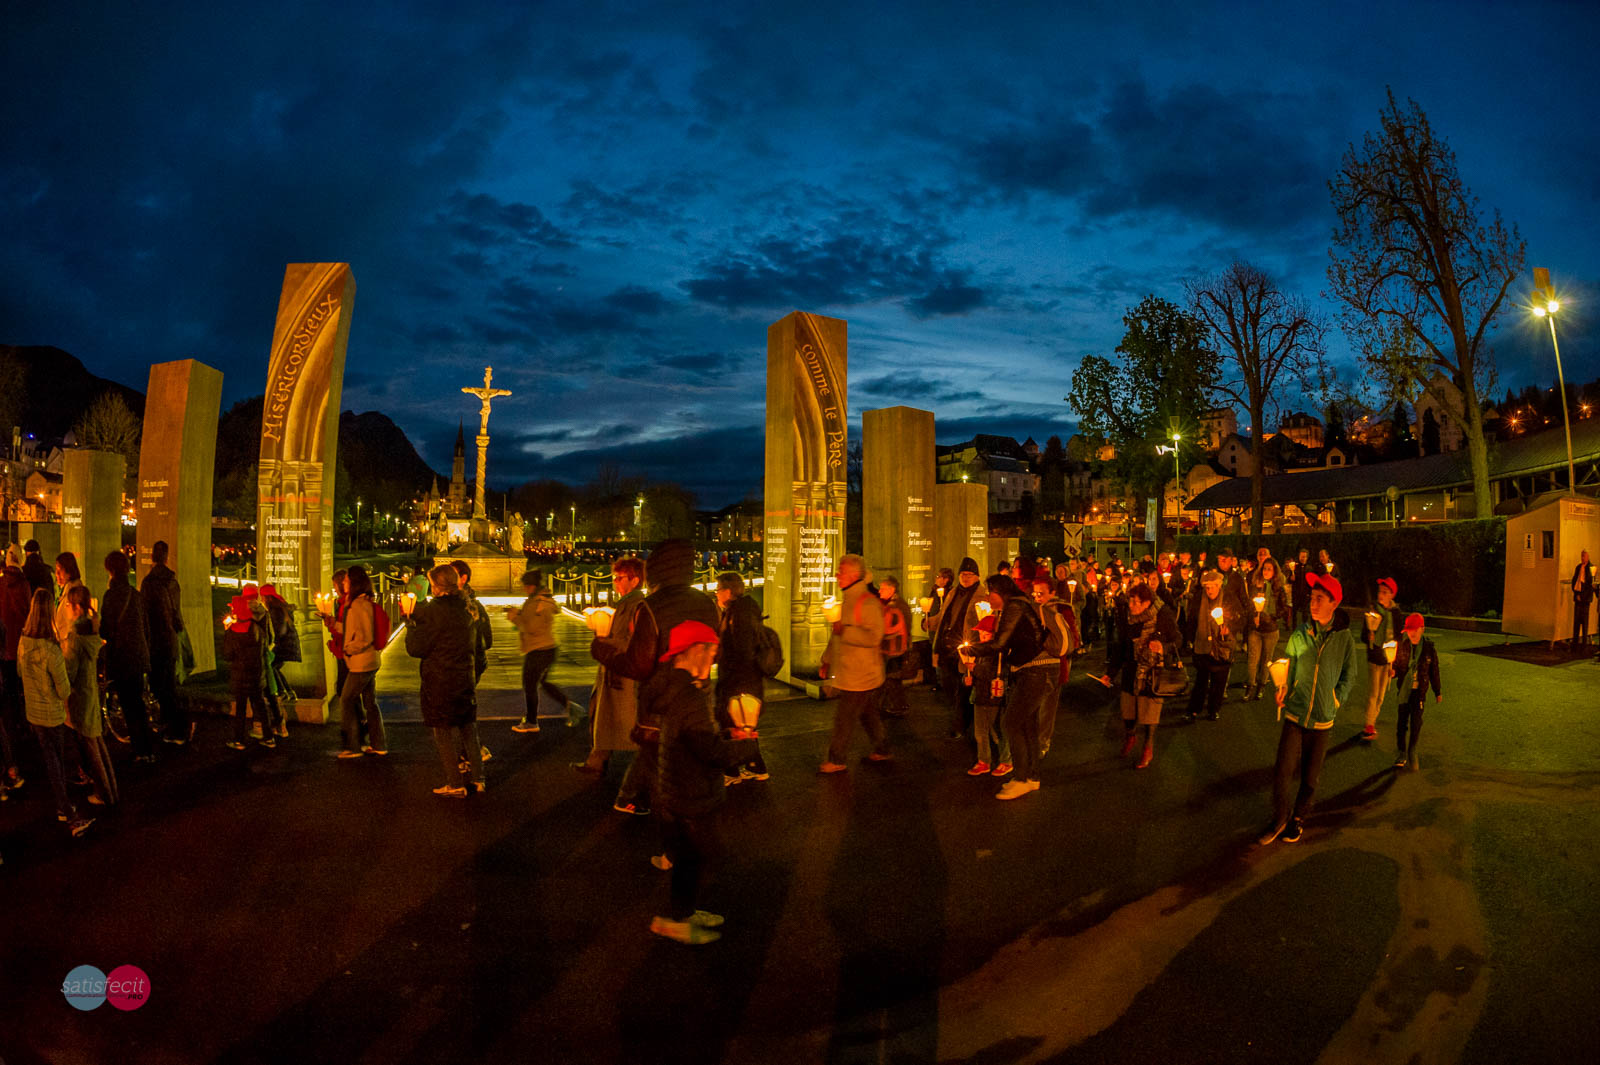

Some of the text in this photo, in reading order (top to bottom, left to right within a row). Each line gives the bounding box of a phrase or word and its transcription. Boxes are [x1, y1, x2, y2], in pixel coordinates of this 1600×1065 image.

[802, 344, 845, 469] comme le Père
